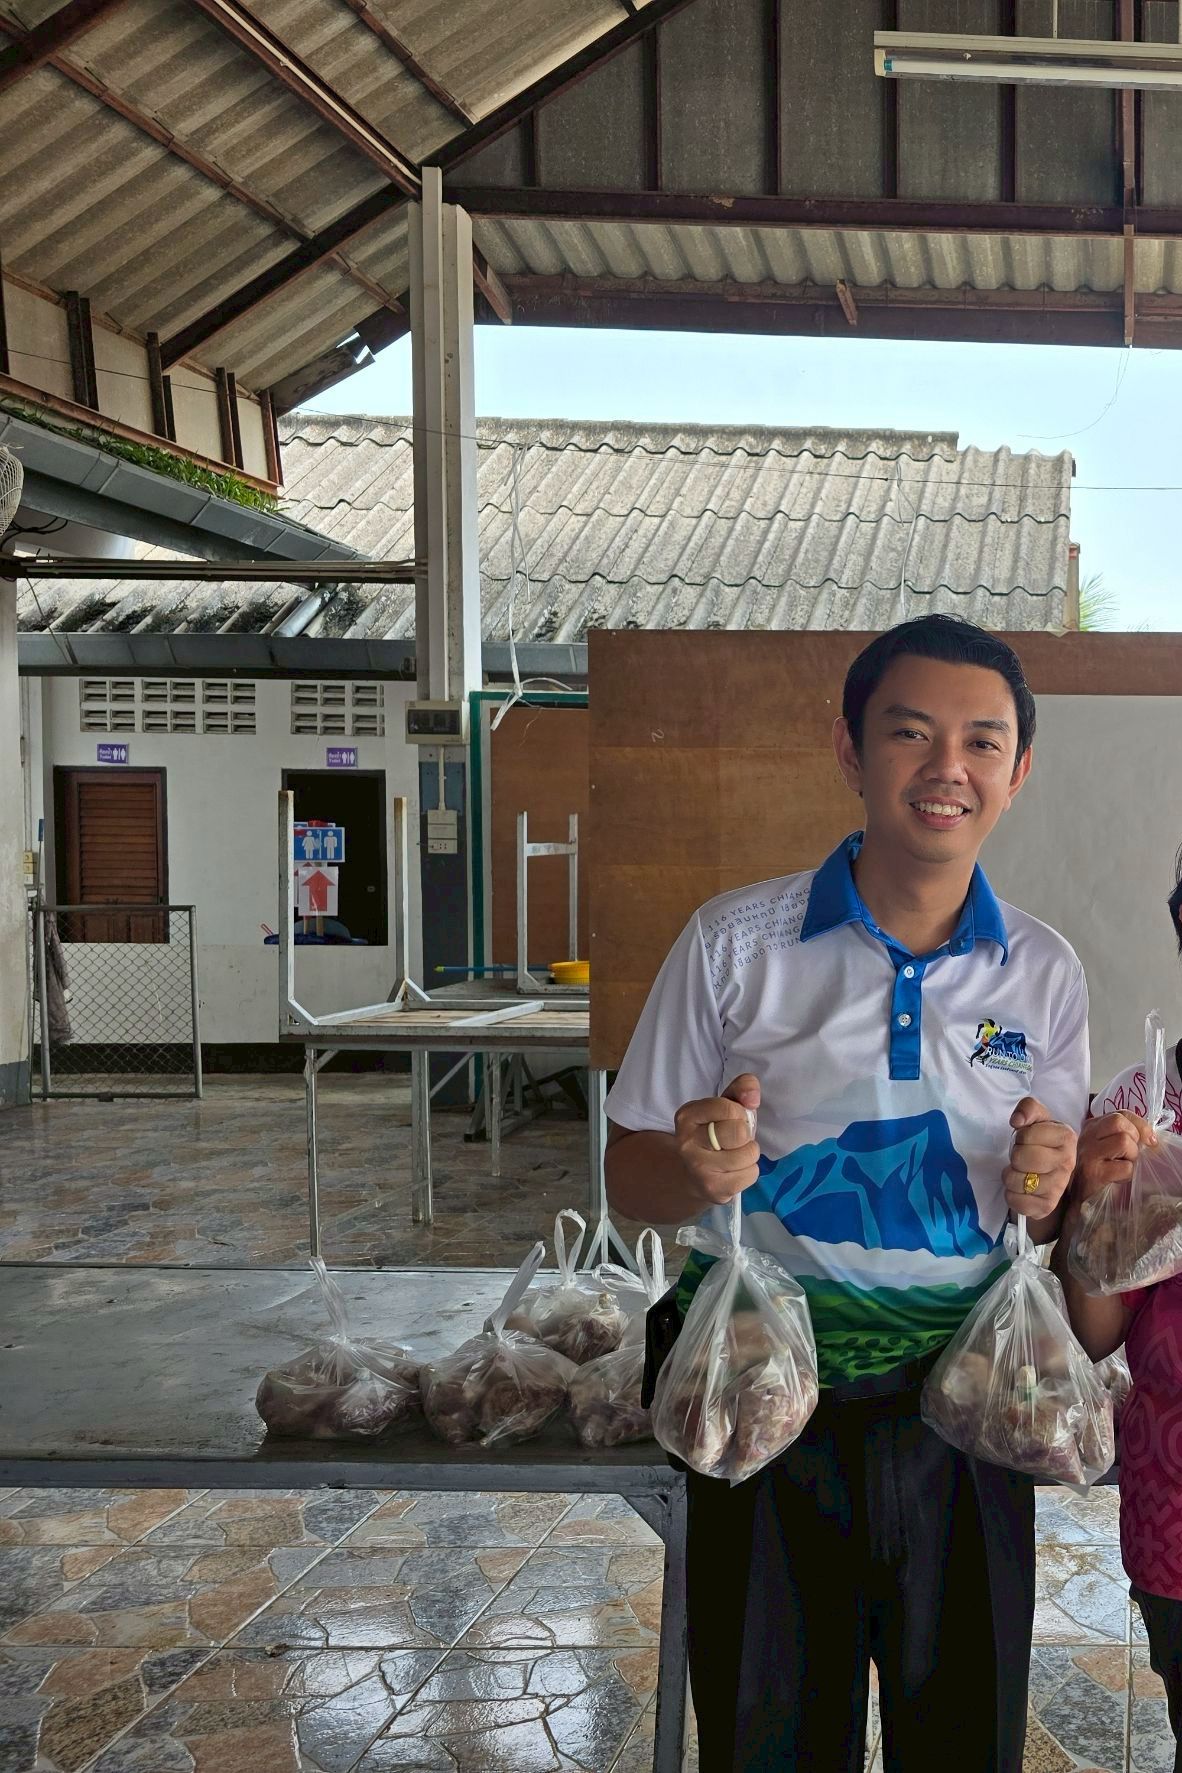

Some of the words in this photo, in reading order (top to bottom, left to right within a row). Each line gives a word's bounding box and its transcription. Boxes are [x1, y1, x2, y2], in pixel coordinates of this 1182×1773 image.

[730, 901, 766, 916] YEARS
[728, 925, 762, 945] YEARS
[764, 912, 804, 931] CHIANG
[761, 925, 801, 941] CHIANG
